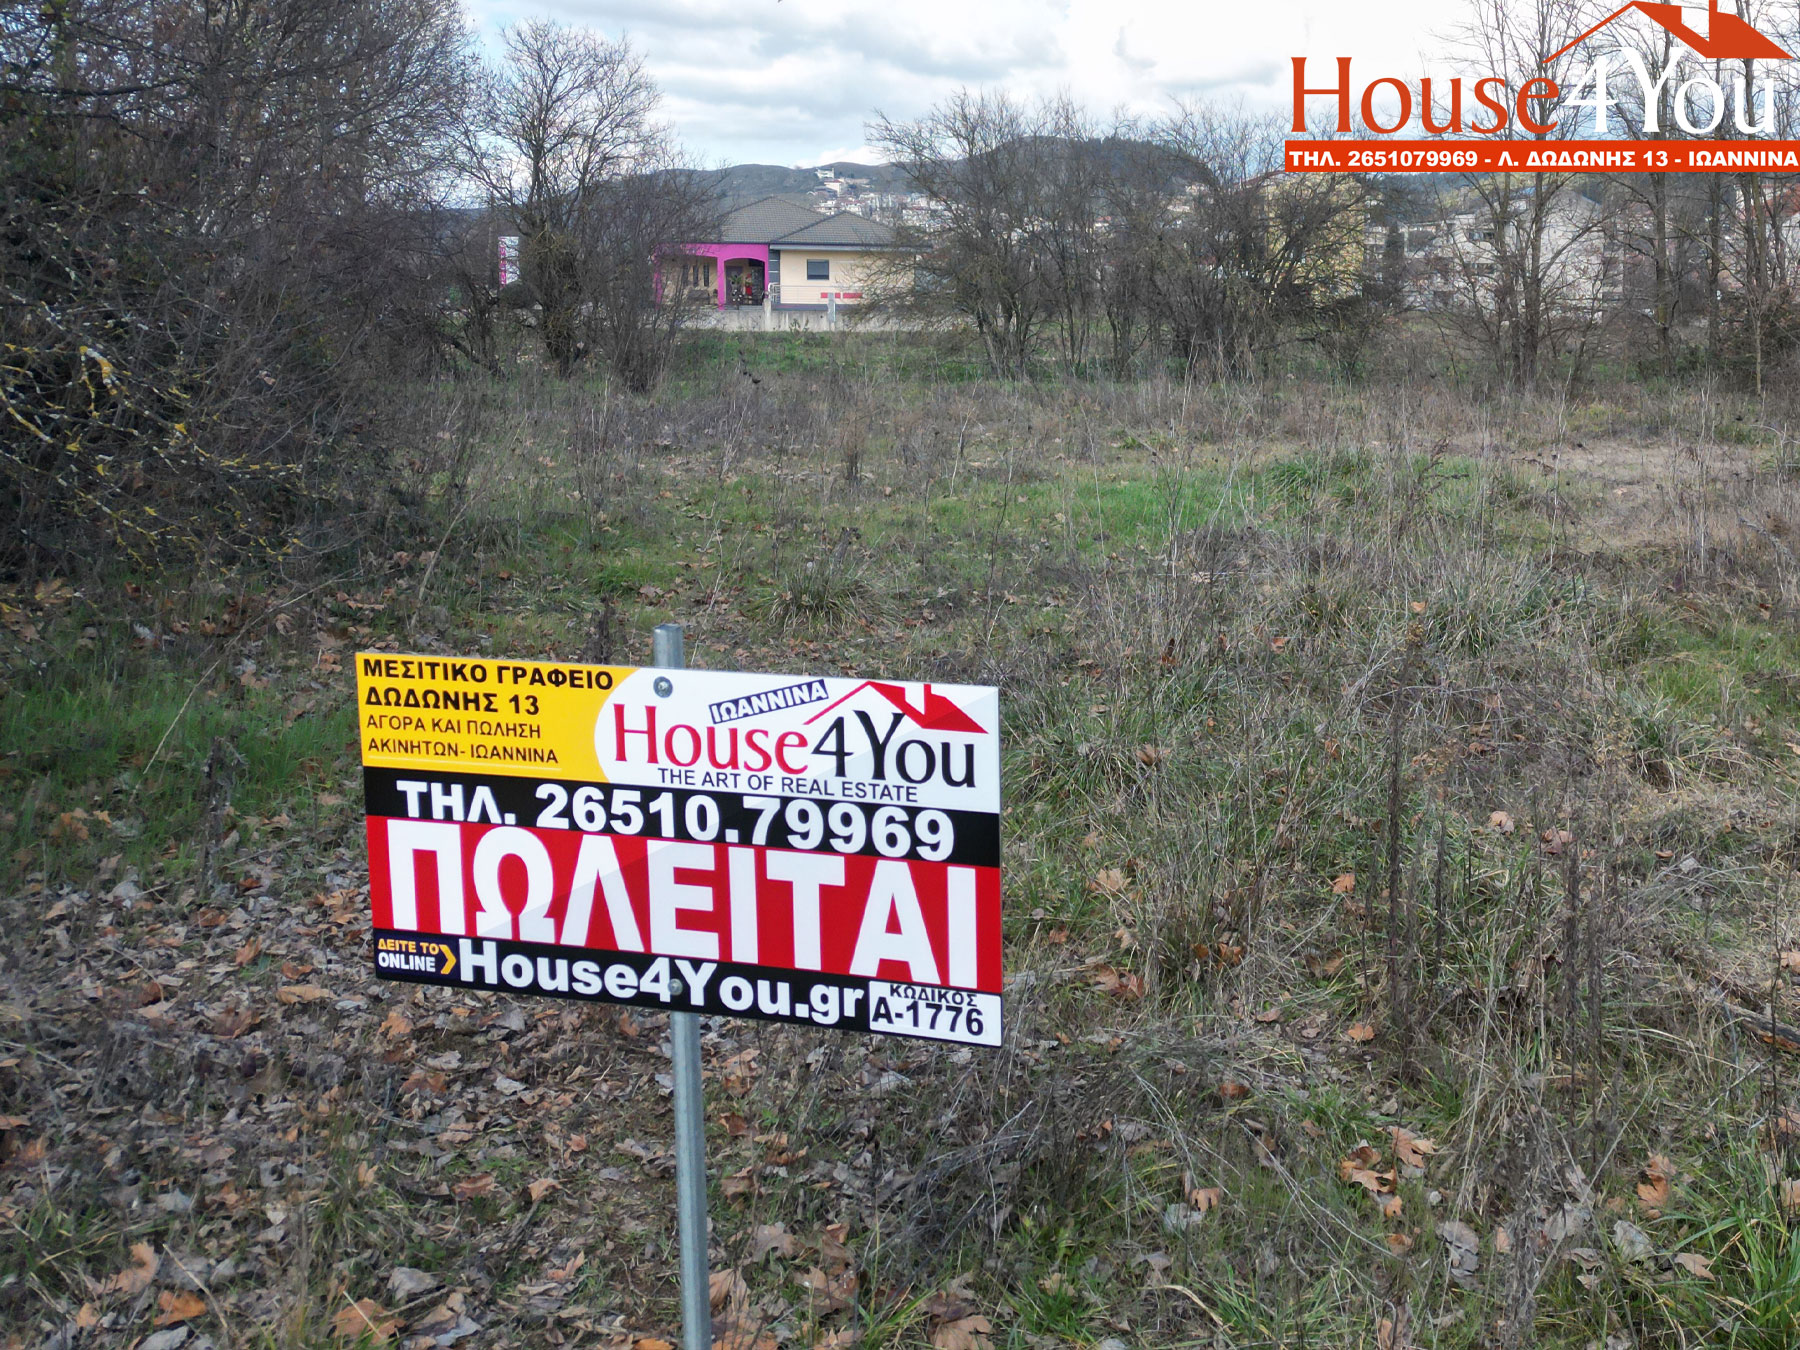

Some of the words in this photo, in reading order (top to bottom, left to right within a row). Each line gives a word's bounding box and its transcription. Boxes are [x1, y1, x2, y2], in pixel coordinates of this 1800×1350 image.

[363, 658, 488, 683] ΜΕΣΙΤΙΚΟ
[496, 665, 614, 691] ΓΡΑΦΕΙΟ
[365, 686, 498, 713] ΔΩΔΩΝΗΣ
[508, 694, 540, 716] 13
[710, 681, 828, 723] ΙΩΑΝΝΙΝΑ
[366, 714, 426, 732] ΑΓΟΡΑ
[432, 718, 461, 734] ΚΑΙ
[467, 720, 541, 739] ΠΩΛΗΣΗ
[470, 745, 559, 764] ΙΩΑΝΝΙΝΑ
[612, 703, 976, 788] House4You
[657, 767, 696, 786] THE
[701, 771, 741, 789] ART
[747, 774, 774, 792] OF
[781, 776, 835, 797] REAL
[841, 781, 919, 803] ESTATE
[395, 779, 517, 825] ΤΗΛ.
[534, 782, 955, 862] 26510.79969
[386, 818, 978, 989] ΠΩΛΕΙΤΑΙ
[377, 937, 417, 953] ΔΕΙΤΕ
[420, 941, 440, 955] ΤΟ
[378, 951, 437, 973] ONLINE
[458, 937, 865, 1025] House4You.gr
[889, 983, 978, 1008] ΚΩΔΙΚΟΣ
[871, 996, 985, 1037] A-1776
